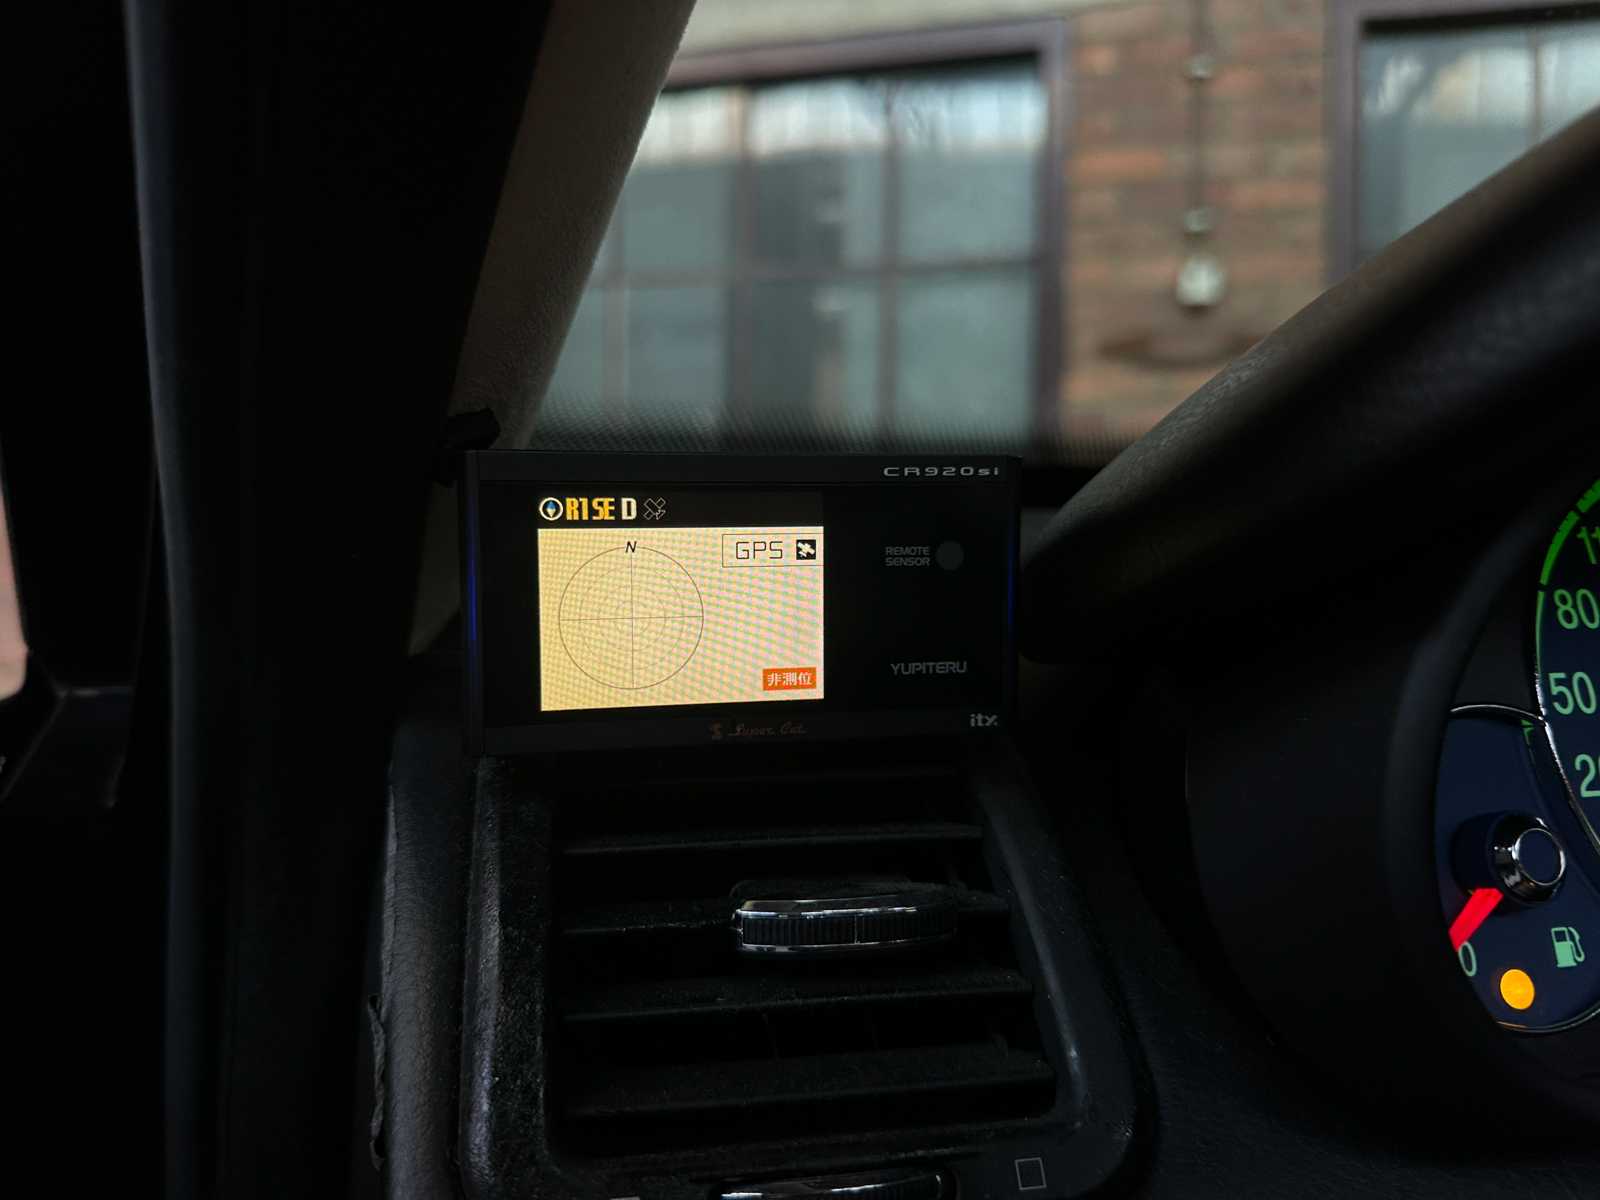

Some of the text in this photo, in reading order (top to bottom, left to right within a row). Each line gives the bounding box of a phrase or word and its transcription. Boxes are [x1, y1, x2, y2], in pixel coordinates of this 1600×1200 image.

[625, 541, 637, 553] N
[735, 541, 783, 560] GPS
[885, 546, 930, 556] REMOTE
[885, 557, 930, 566] SENSOR
[1553, 588, 1600, 630] 80
[890, 661, 968, 675] YUPITERU
[767, 671, 813, 687] 非測位
[1548, 671, 1597, 715] 50
[1575, 754, 1600, 798] 2
[1458, 941, 1477, 977] 0
